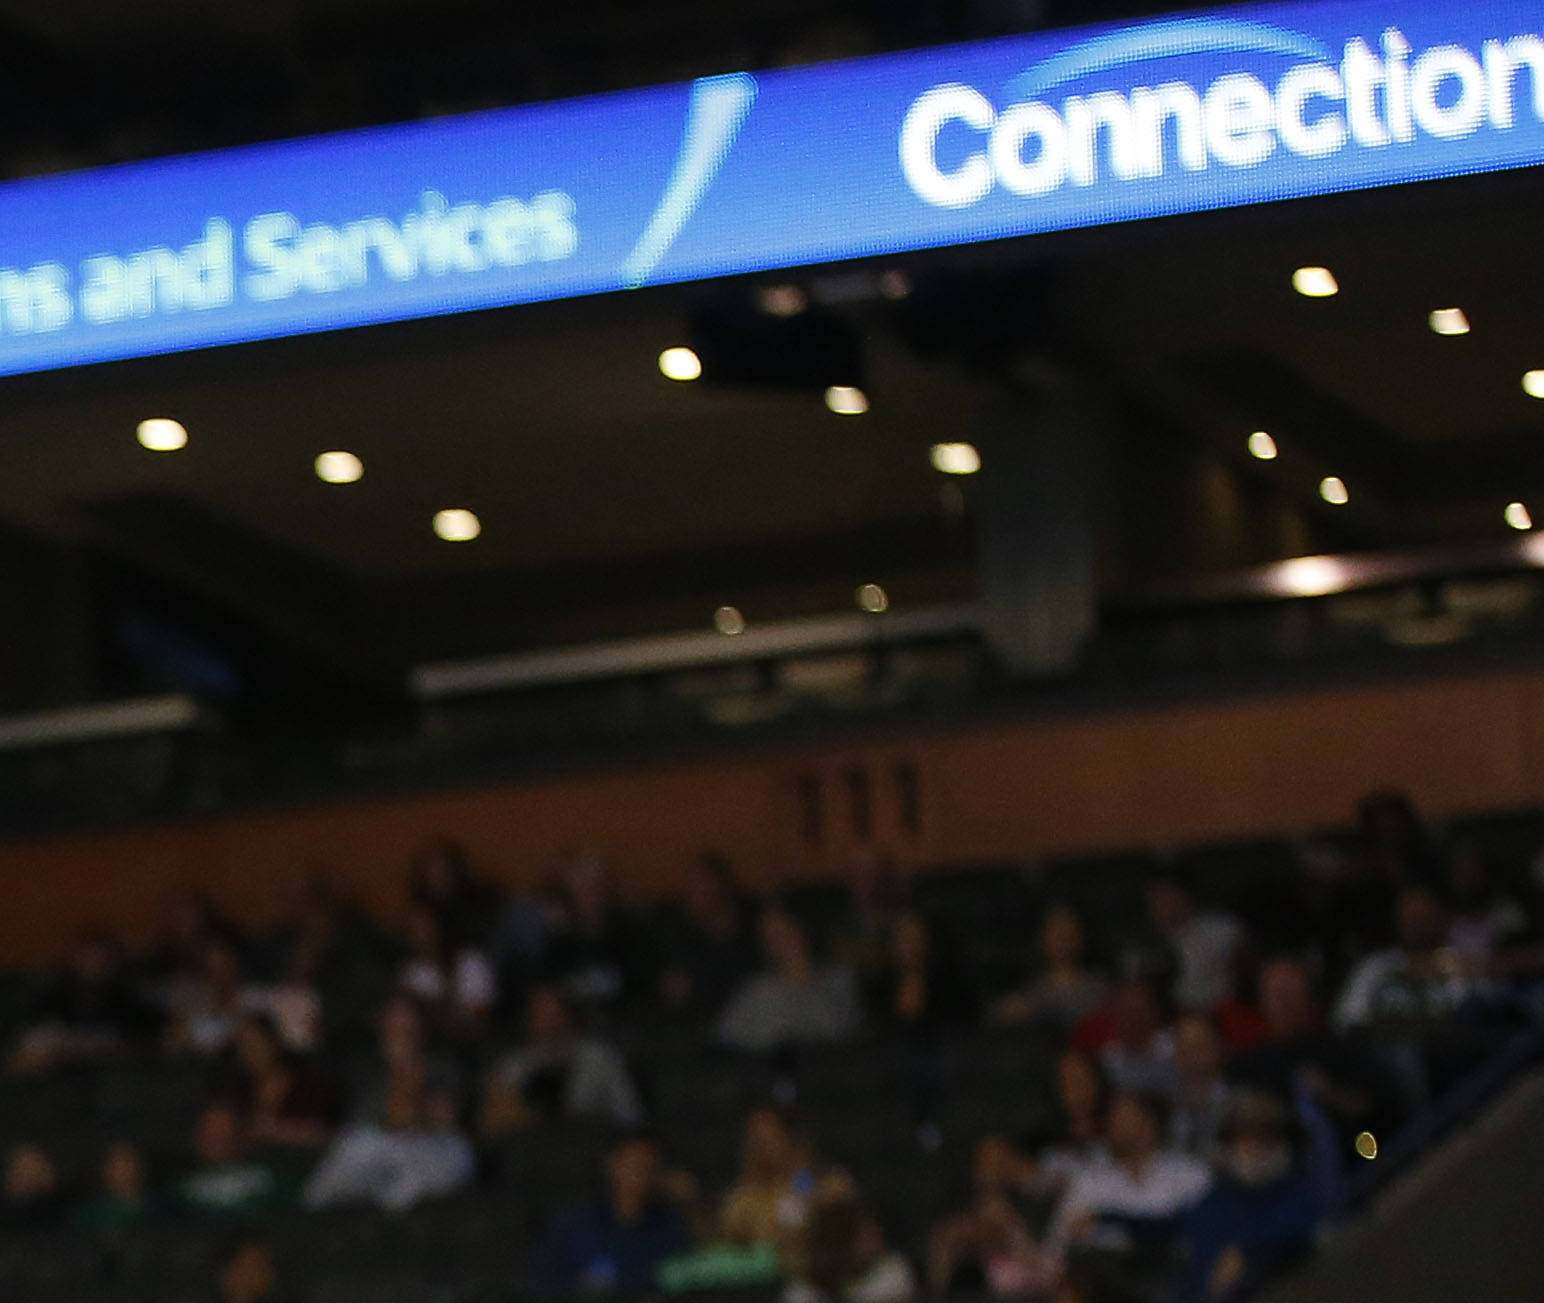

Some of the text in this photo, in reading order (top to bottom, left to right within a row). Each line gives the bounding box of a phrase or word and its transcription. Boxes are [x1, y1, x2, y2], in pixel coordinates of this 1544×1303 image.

[900, 28, 1544, 209] Connection
[82, 216, 233, 325] and
[242, 187, 577, 302] Services
